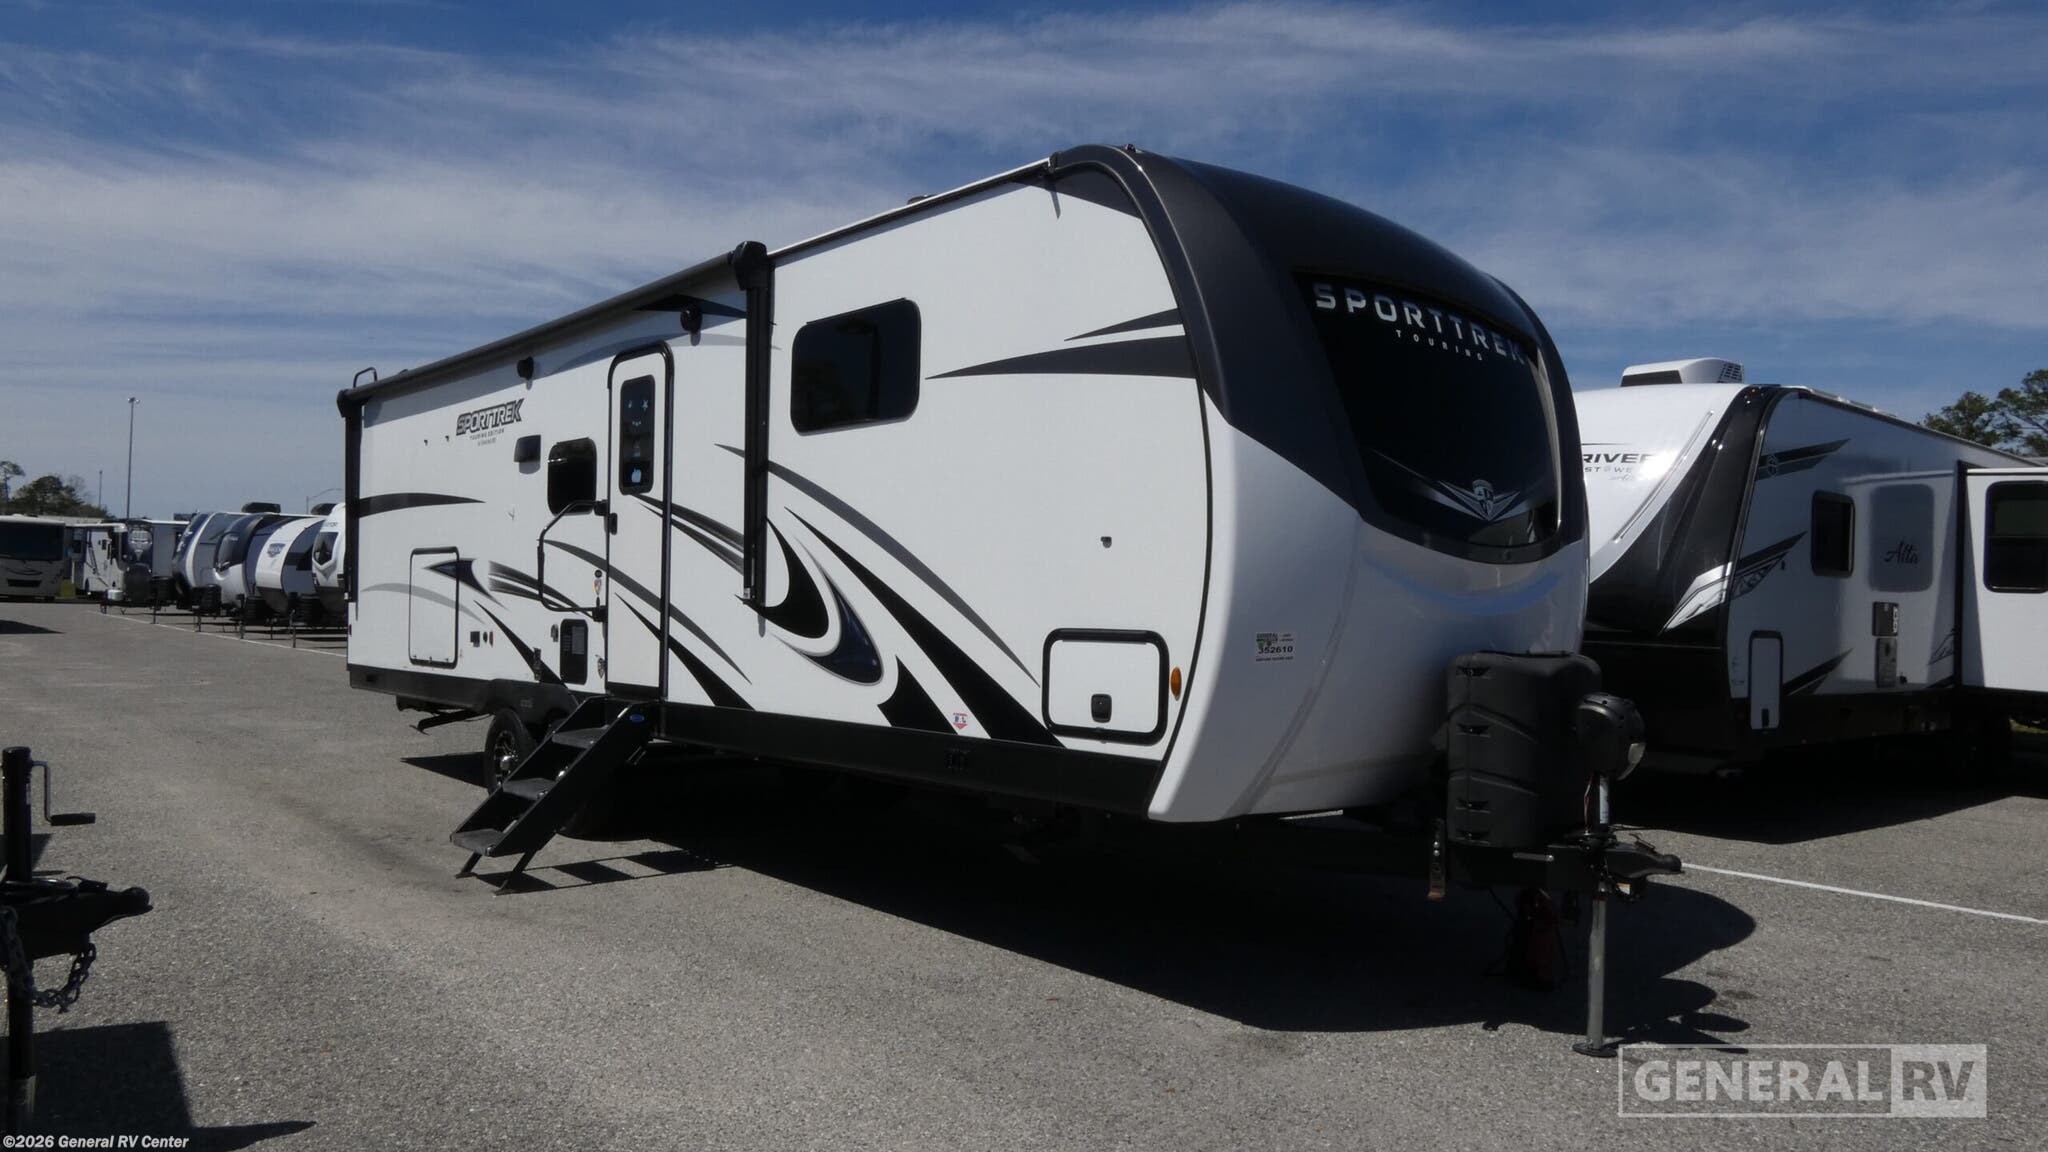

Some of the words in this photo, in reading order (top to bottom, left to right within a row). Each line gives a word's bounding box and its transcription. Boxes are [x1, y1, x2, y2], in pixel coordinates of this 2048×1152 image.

[1312, 283, 1526, 364] SPORTTREK
[1395, 329, 1483, 361] TOURING
[456, 398, 525, 436] SPORTTREK
